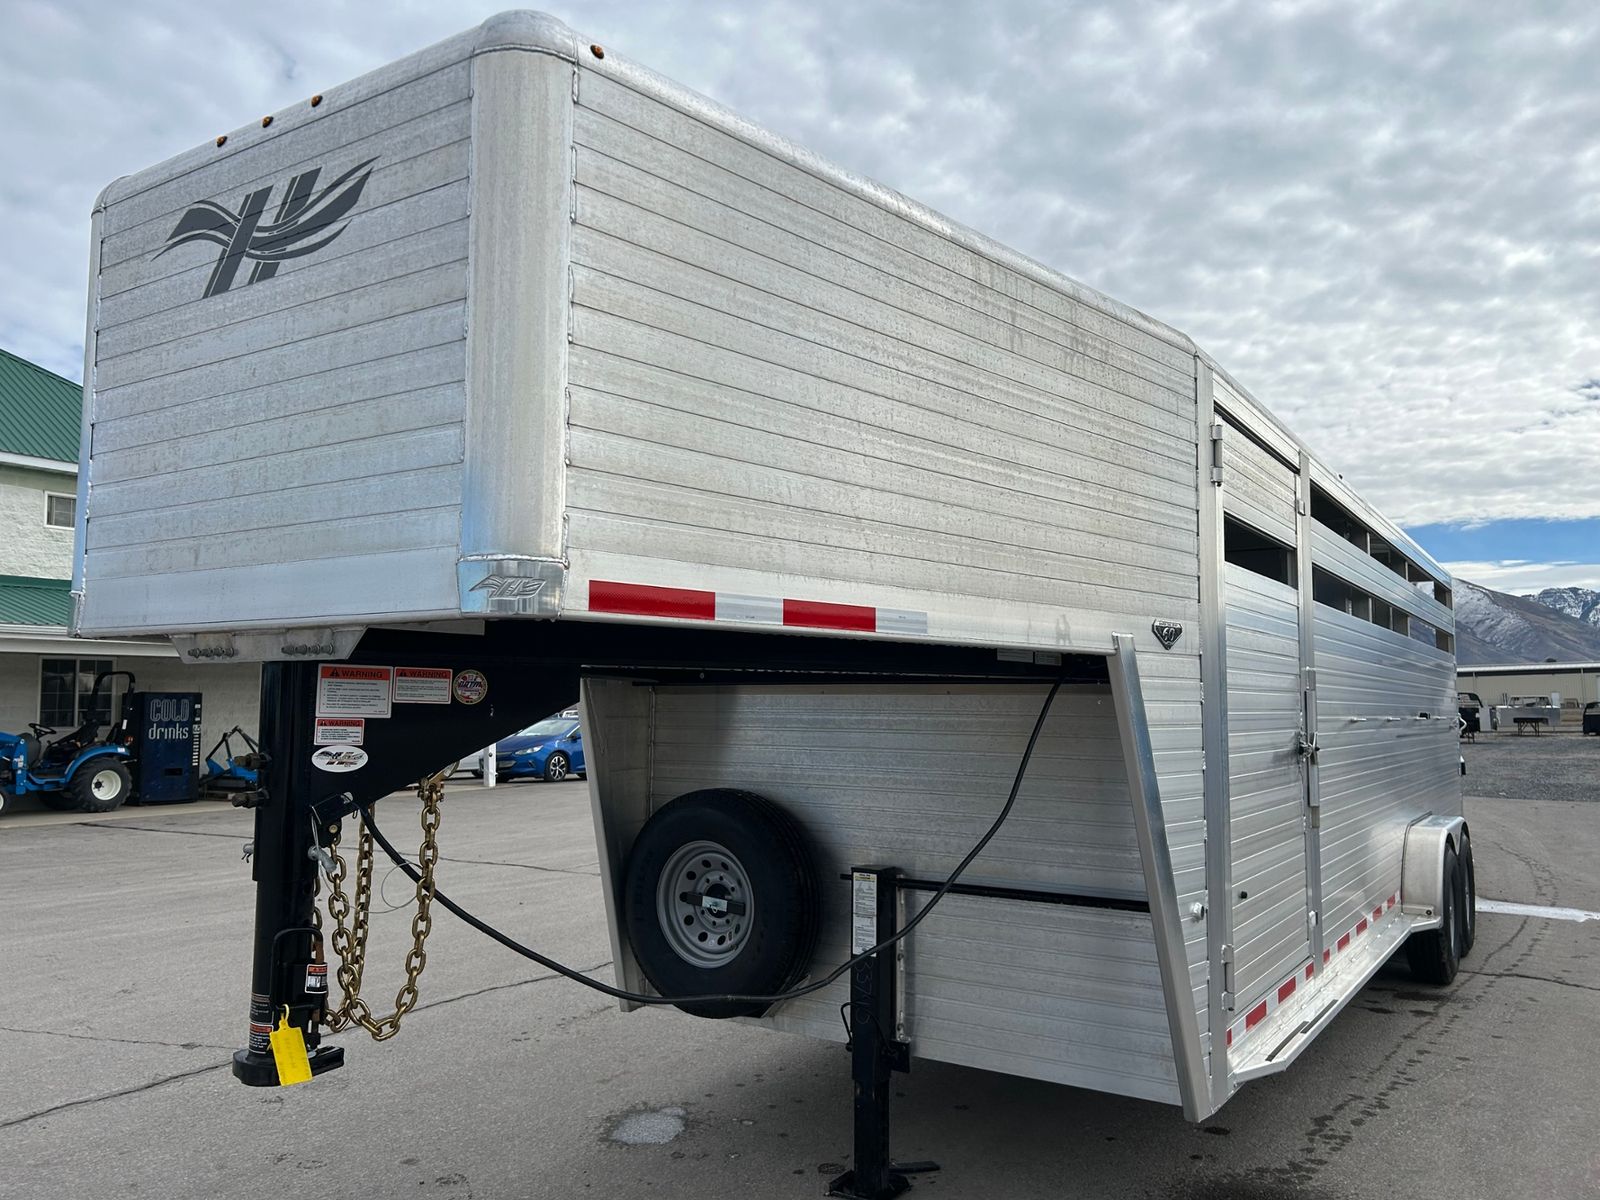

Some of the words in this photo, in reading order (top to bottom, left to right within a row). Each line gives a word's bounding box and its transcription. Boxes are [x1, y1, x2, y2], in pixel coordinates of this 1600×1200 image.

[341, 670, 383, 679] WARNING
[409, 671, 447, 679] WARNING
[150, 699, 190, 721] COLD
[148, 722, 189, 740] drinks
